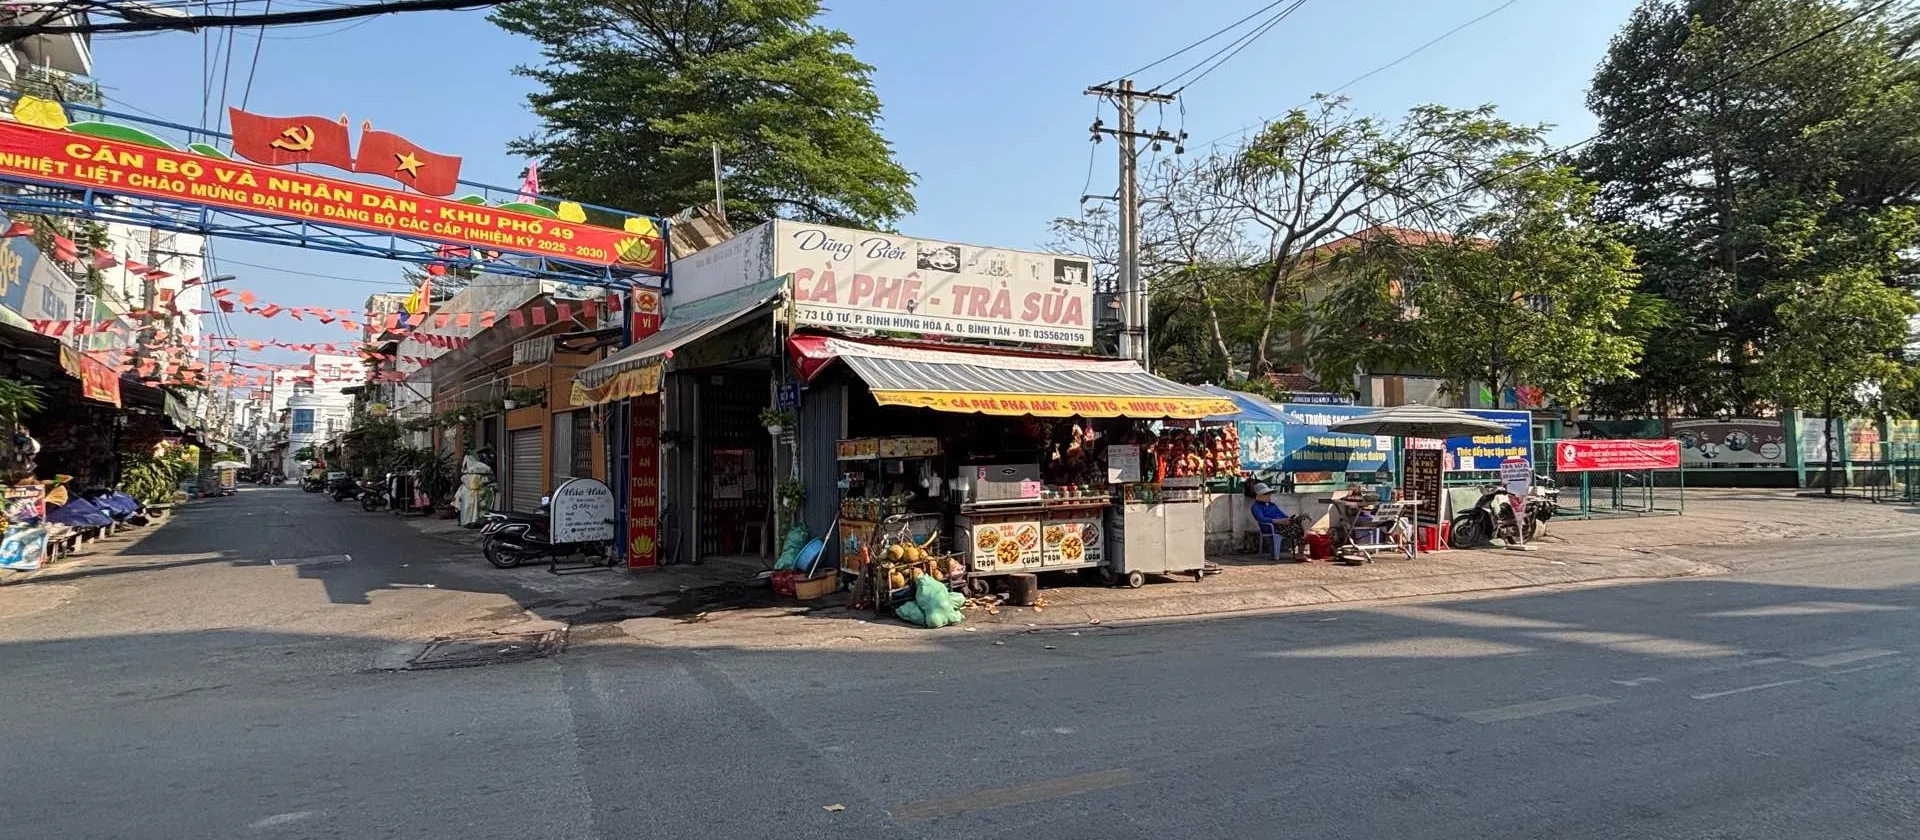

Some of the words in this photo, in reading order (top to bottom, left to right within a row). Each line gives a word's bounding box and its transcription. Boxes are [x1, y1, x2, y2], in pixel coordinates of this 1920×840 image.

[0, 153, 68, 178] NHIỆT
[75, 165, 123, 185] LIỆT
[128, 171, 186, 193] CHÀO
[191, 182, 248, 203] MỪNG
[253, 192, 283, 210] ĐẠI
[289, 198, 319, 217] HỘI
[323, 202, 369, 222] ĐẢNG
[374, 212, 395, 229] BỘ
[400, 216, 429, 231] CÁC
[433, 219, 462, 234] CẤP
[464, 227, 513, 246] (NHIỆM
[516, 233, 534, 247] KỲ
[538, 239, 566, 253] 2025
[576, 246, 607, 261] 2030)
[65, 143, 144, 168] CÁN
[156, 157, 203, 180] BỘ
[214, 166, 258, 188] VÀ
[268, 176, 353, 204] NHÂN
[362, 193, 417, 214] DÂN
[440, 207, 491, 227] KHU
[498, 213, 543, 235] PHỐ
[549, 226, 574, 240] 49
[793, 229, 853, 261] Dũng
[794, 261, 837, 304] CÀ
[848, 271, 922, 311] PHÊ
[930, 297, 940, 305] -
[952, 280, 1012, 319] TRÀ
[1021, 287, 1084, 326] SỮA
[805, 310, 818, 320] 73
[866, 314, 890, 327] BÌNH
[893, 317, 920, 330] HƯNG
[968, 323, 990, 335] BÌNH
[993, 323, 1010, 337] TÂN
[1033, 330, 1085, 342] 0355620159
[1069, 400, 1099, 412] SINH
